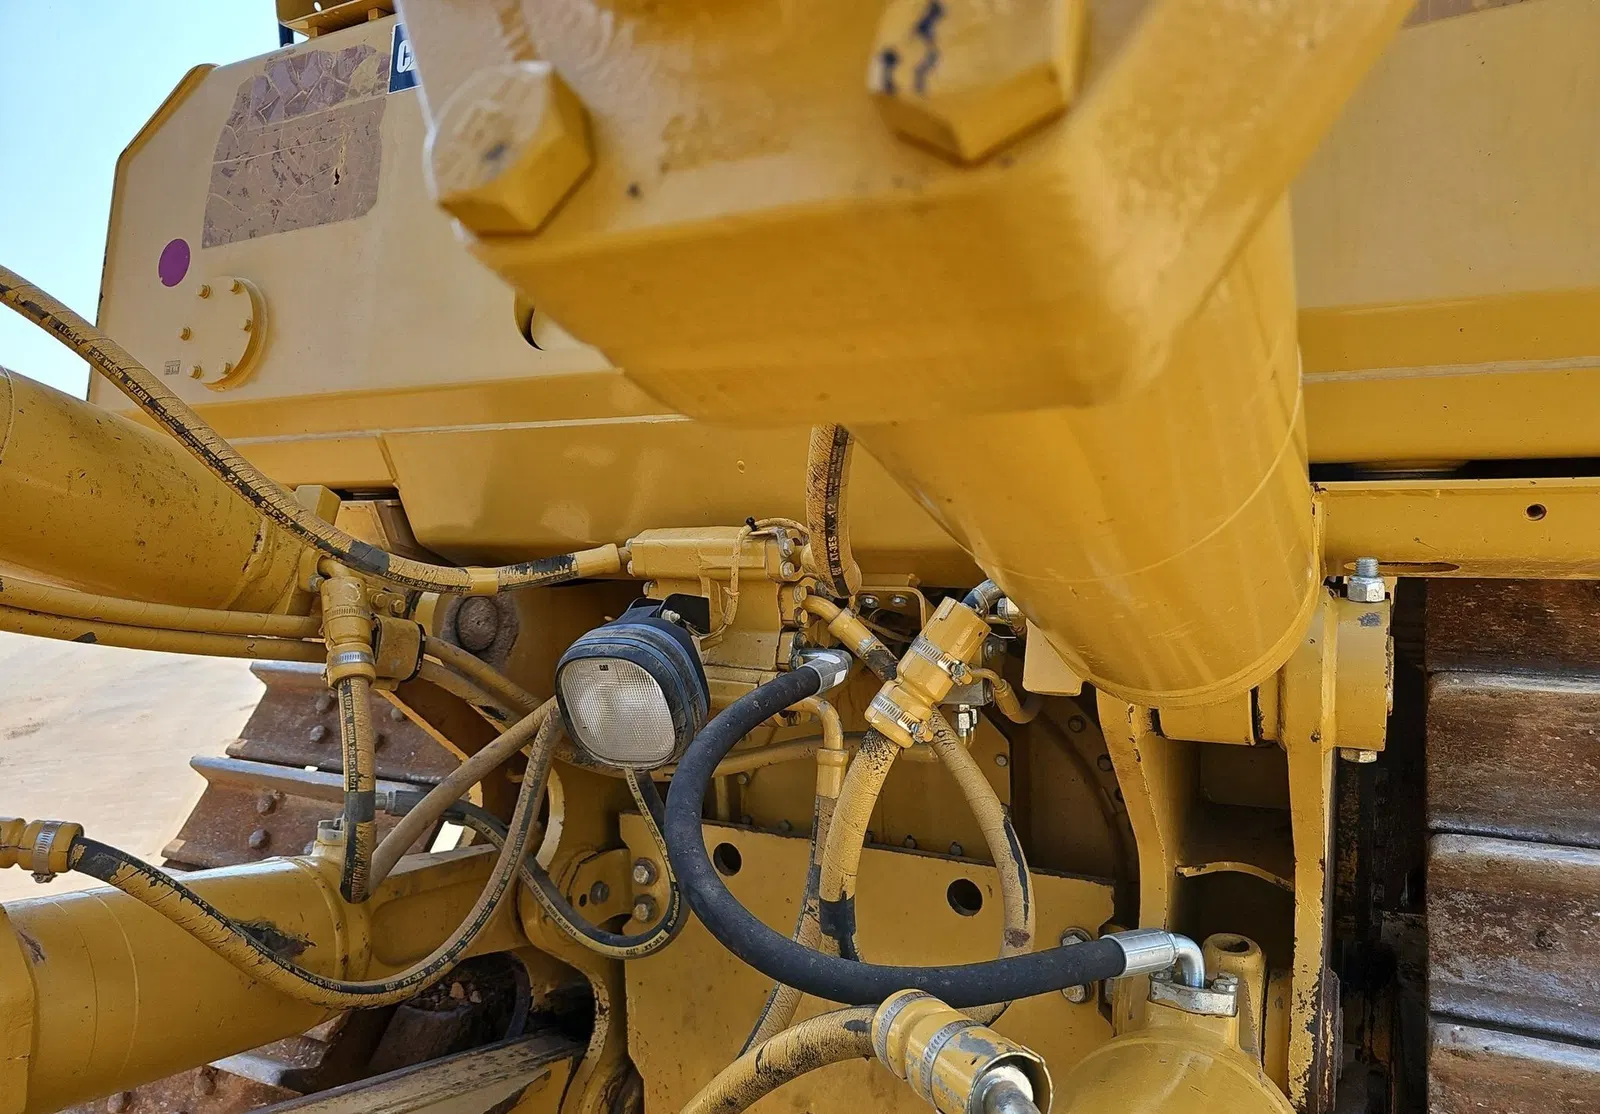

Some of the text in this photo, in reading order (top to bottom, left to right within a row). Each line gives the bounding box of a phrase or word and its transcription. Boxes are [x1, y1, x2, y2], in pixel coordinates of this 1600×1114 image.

[102, 358, 124, 378] MSHA
[125, 378, 151, 403] 1E0736
[258, 499, 294, 528] XT-3ES
[828, 535, 838, 560] XT-3ES
[401, 970, 426, 985] XT-3ES
